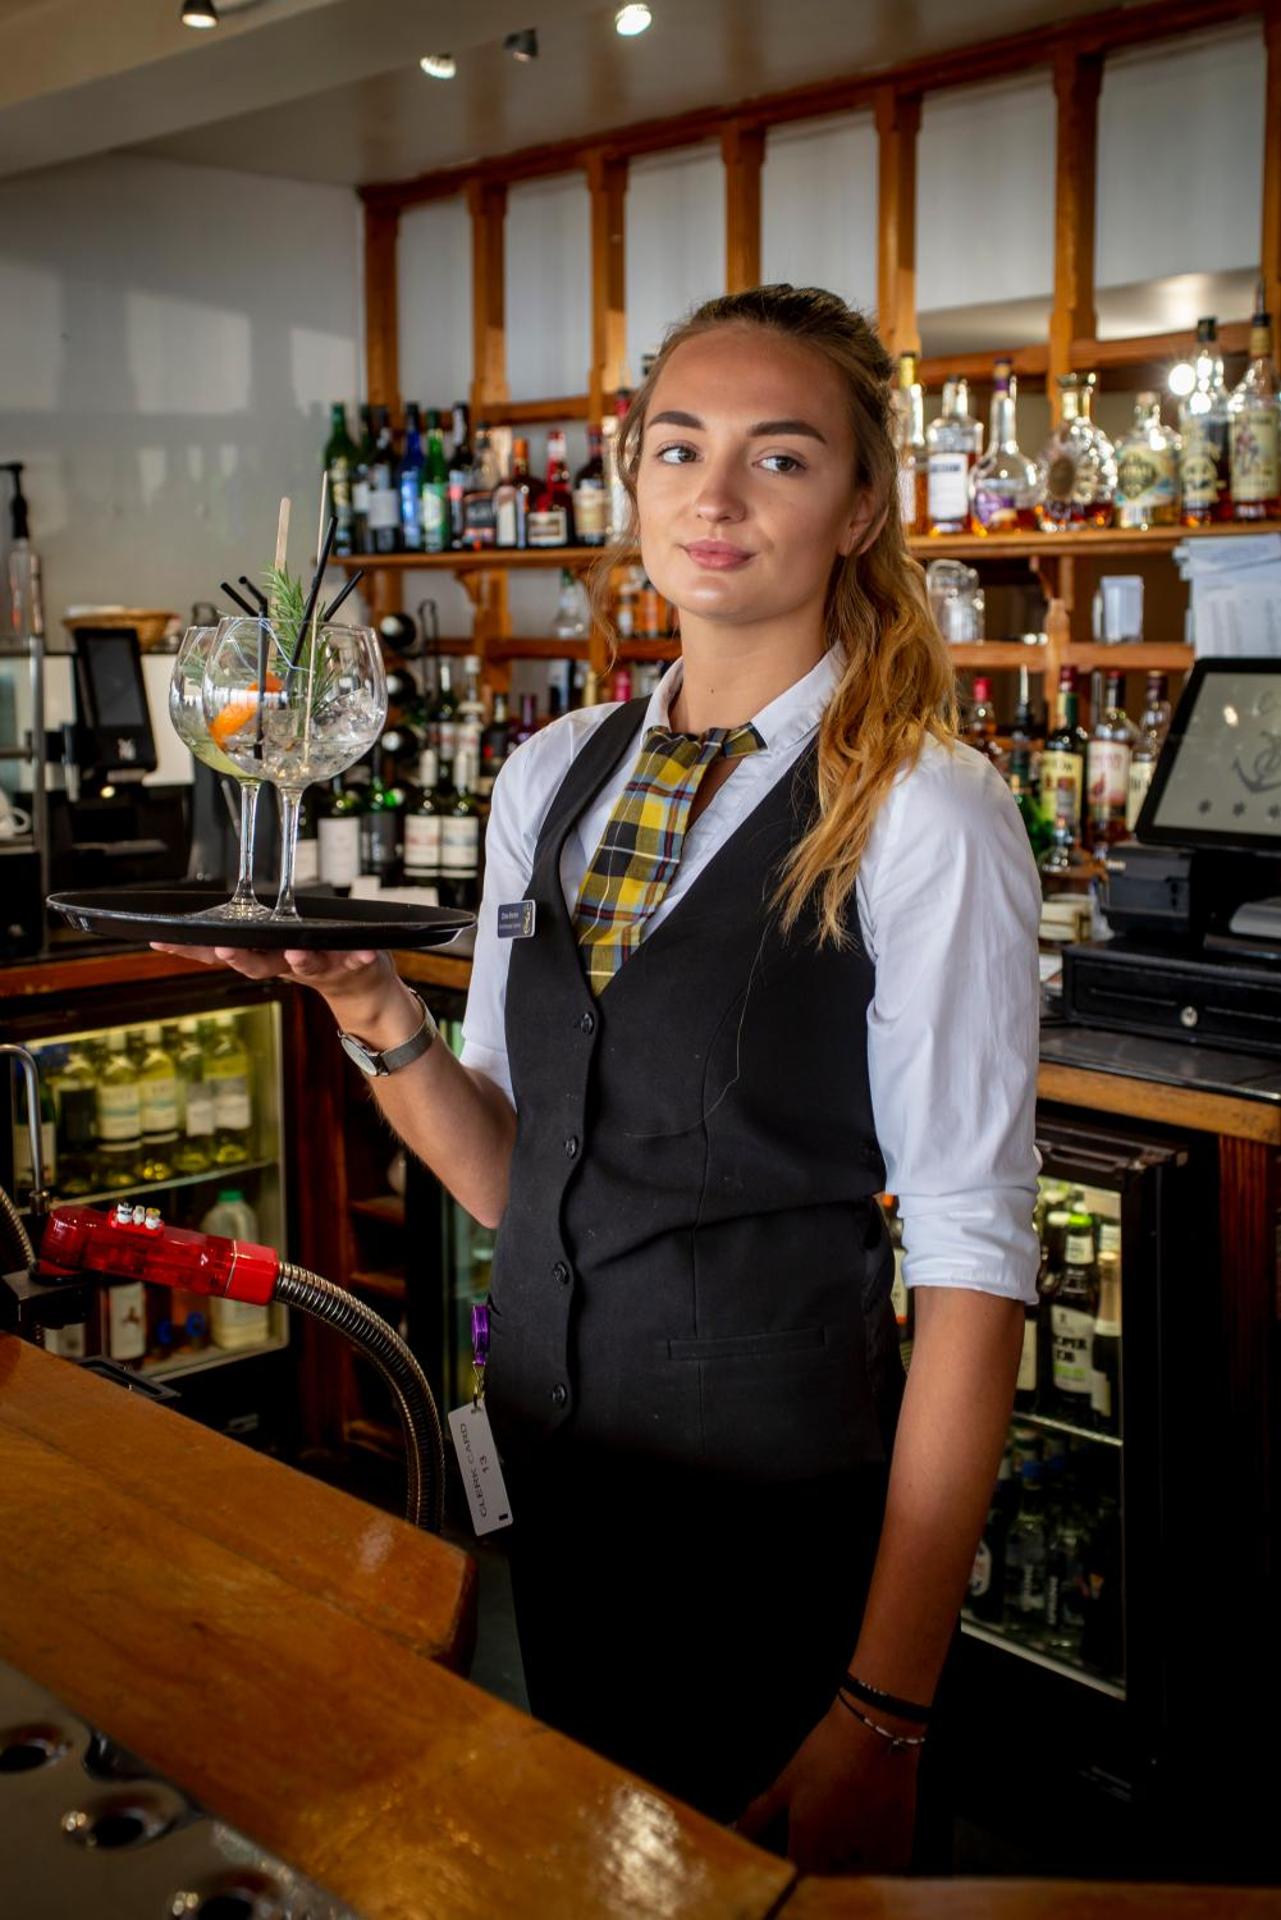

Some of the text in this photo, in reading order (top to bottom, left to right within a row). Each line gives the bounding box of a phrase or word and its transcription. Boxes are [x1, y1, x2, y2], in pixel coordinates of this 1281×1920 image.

[460, 1423, 487, 1518] CLERK CARD
[479, 1455, 490, 1474] 13
